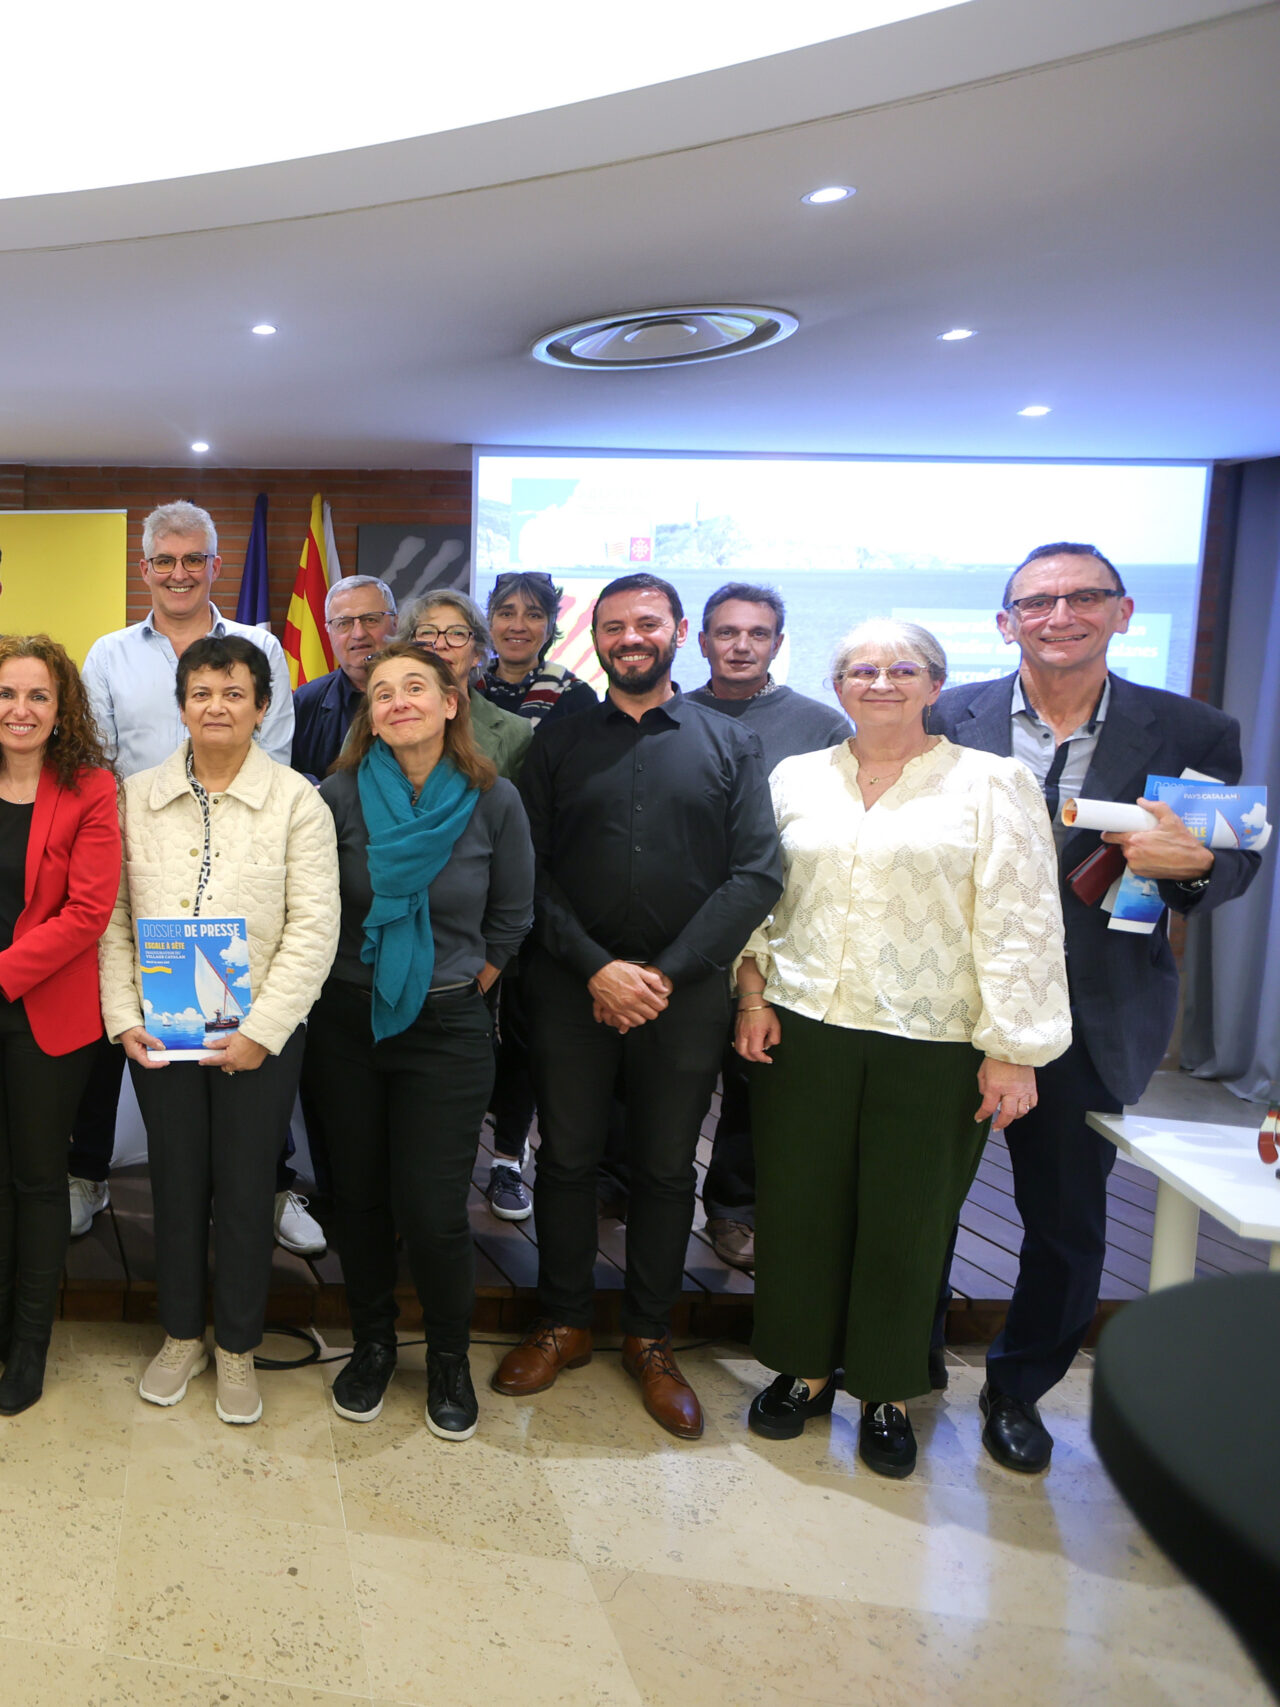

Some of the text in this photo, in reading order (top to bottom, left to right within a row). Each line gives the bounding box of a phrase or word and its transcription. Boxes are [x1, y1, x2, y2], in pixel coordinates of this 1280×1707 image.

[143, 923, 240, 938] DOSSIER DE PRESSE
